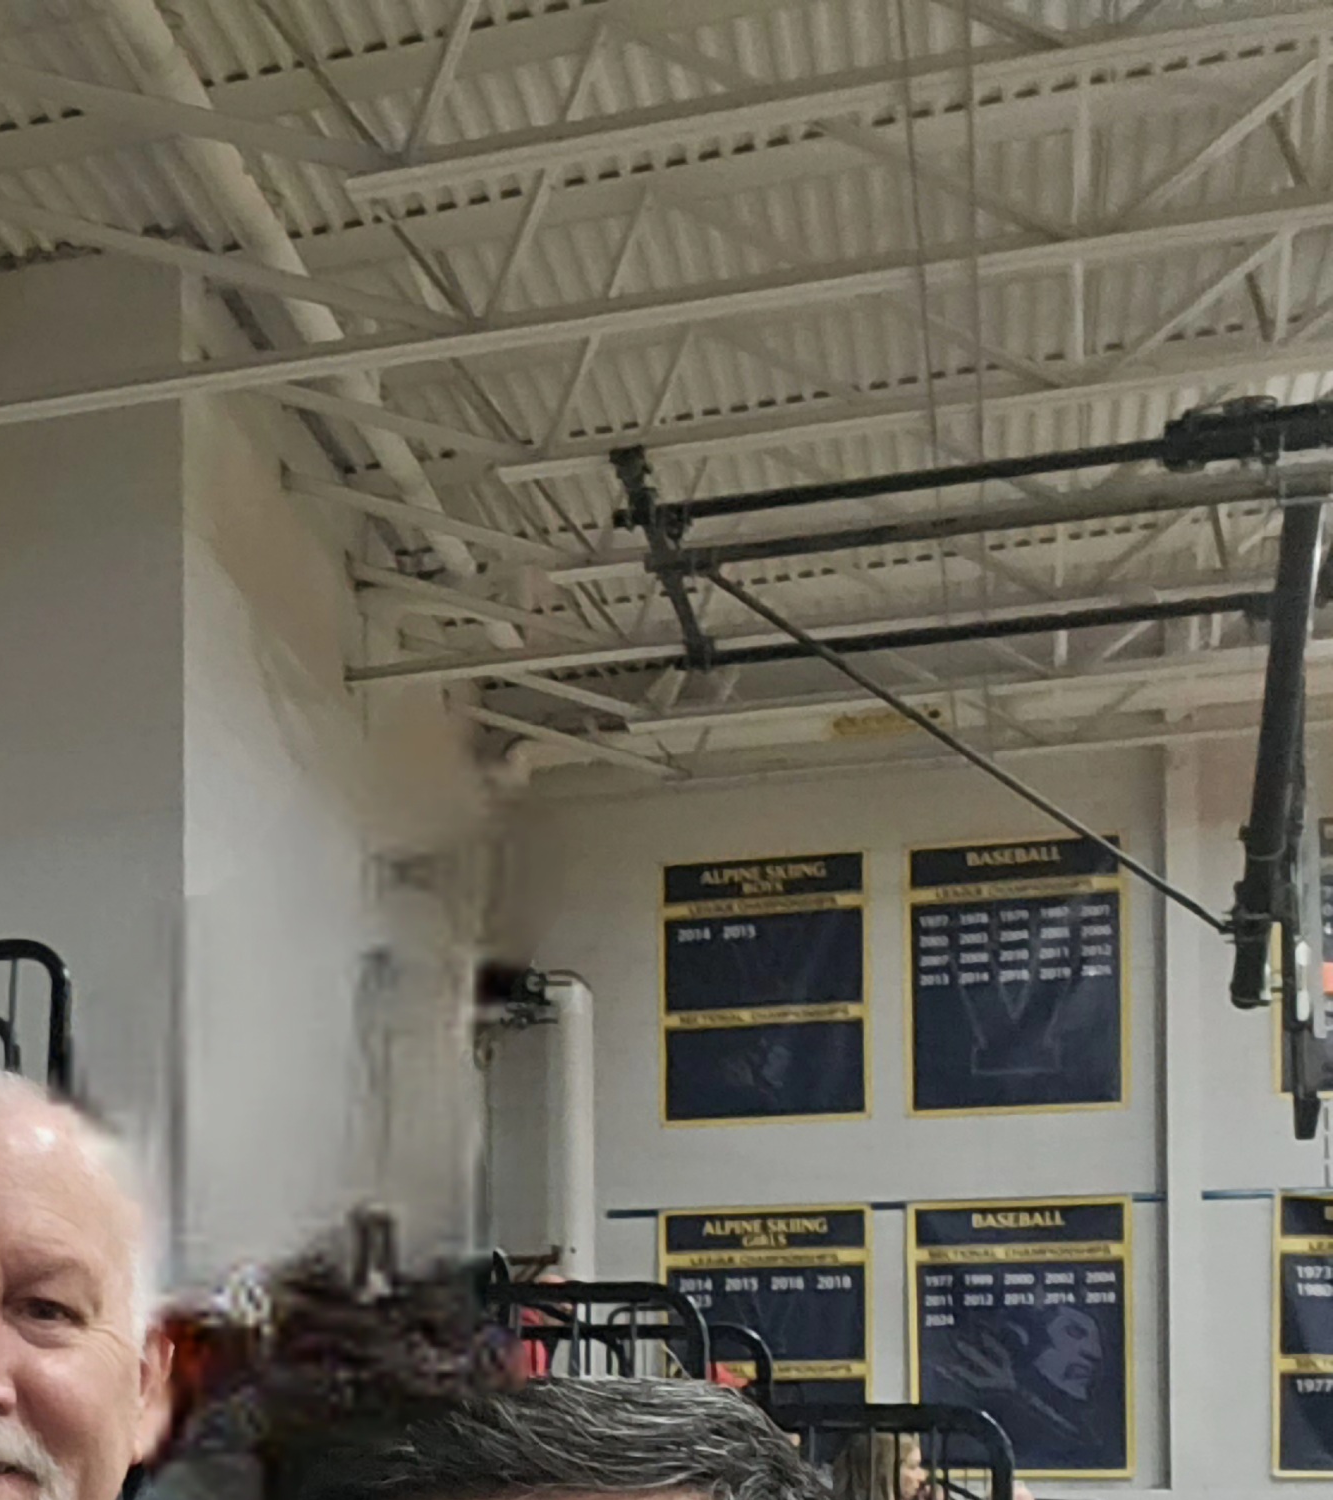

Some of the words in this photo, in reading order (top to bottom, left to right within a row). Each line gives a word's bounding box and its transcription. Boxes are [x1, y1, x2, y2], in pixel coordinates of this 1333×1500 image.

[966, 846, 1061, 867] BASEBALL
[700, 866, 760, 886] ALPINE
[702, 1219, 760, 1236] ALPINE
[766, 1216, 829, 1233] SKIING
[971, 1210, 1065, 1229] BASEBALL
